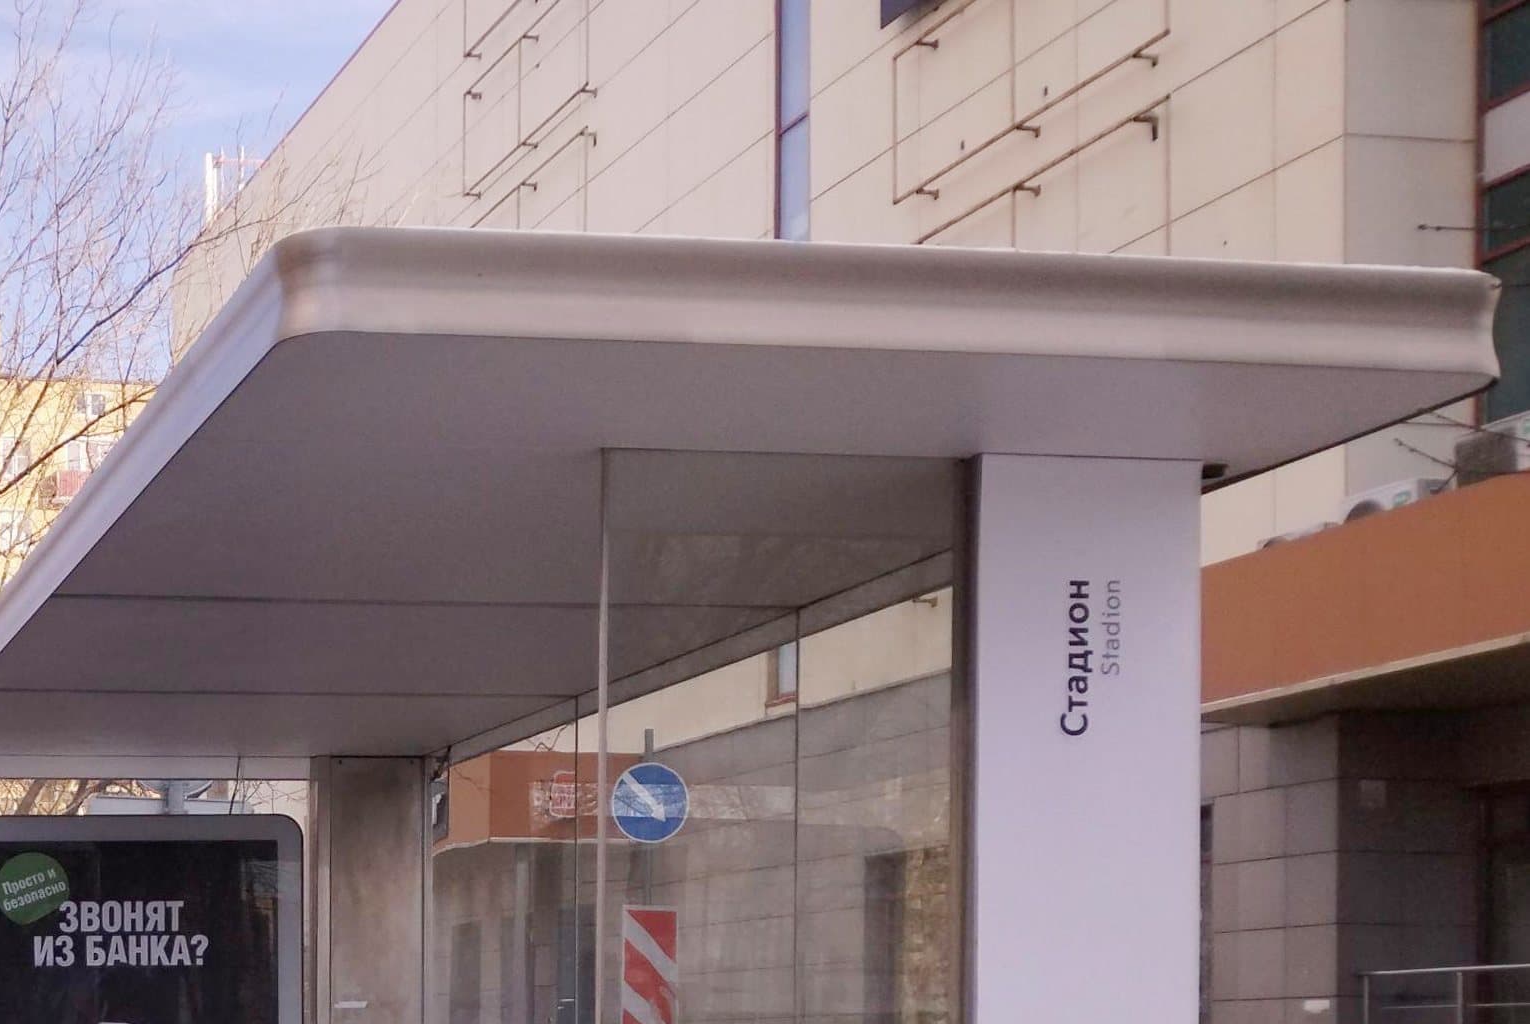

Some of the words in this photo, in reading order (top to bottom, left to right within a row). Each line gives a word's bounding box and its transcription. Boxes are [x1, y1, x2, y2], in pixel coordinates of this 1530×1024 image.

[1100, 580, 1121, 676] Stadion
[1060, 580, 1094, 736] Стадион
[2, 872, 46, 895] Просто
[47, 868, 57, 879] и
[3, 881, 66, 911] безопасно
[58, 900, 185, 933] ЗВОНЯТ
[33, 935, 75, 968] ИЗ
[85, 934, 210, 967] БАНКА?
